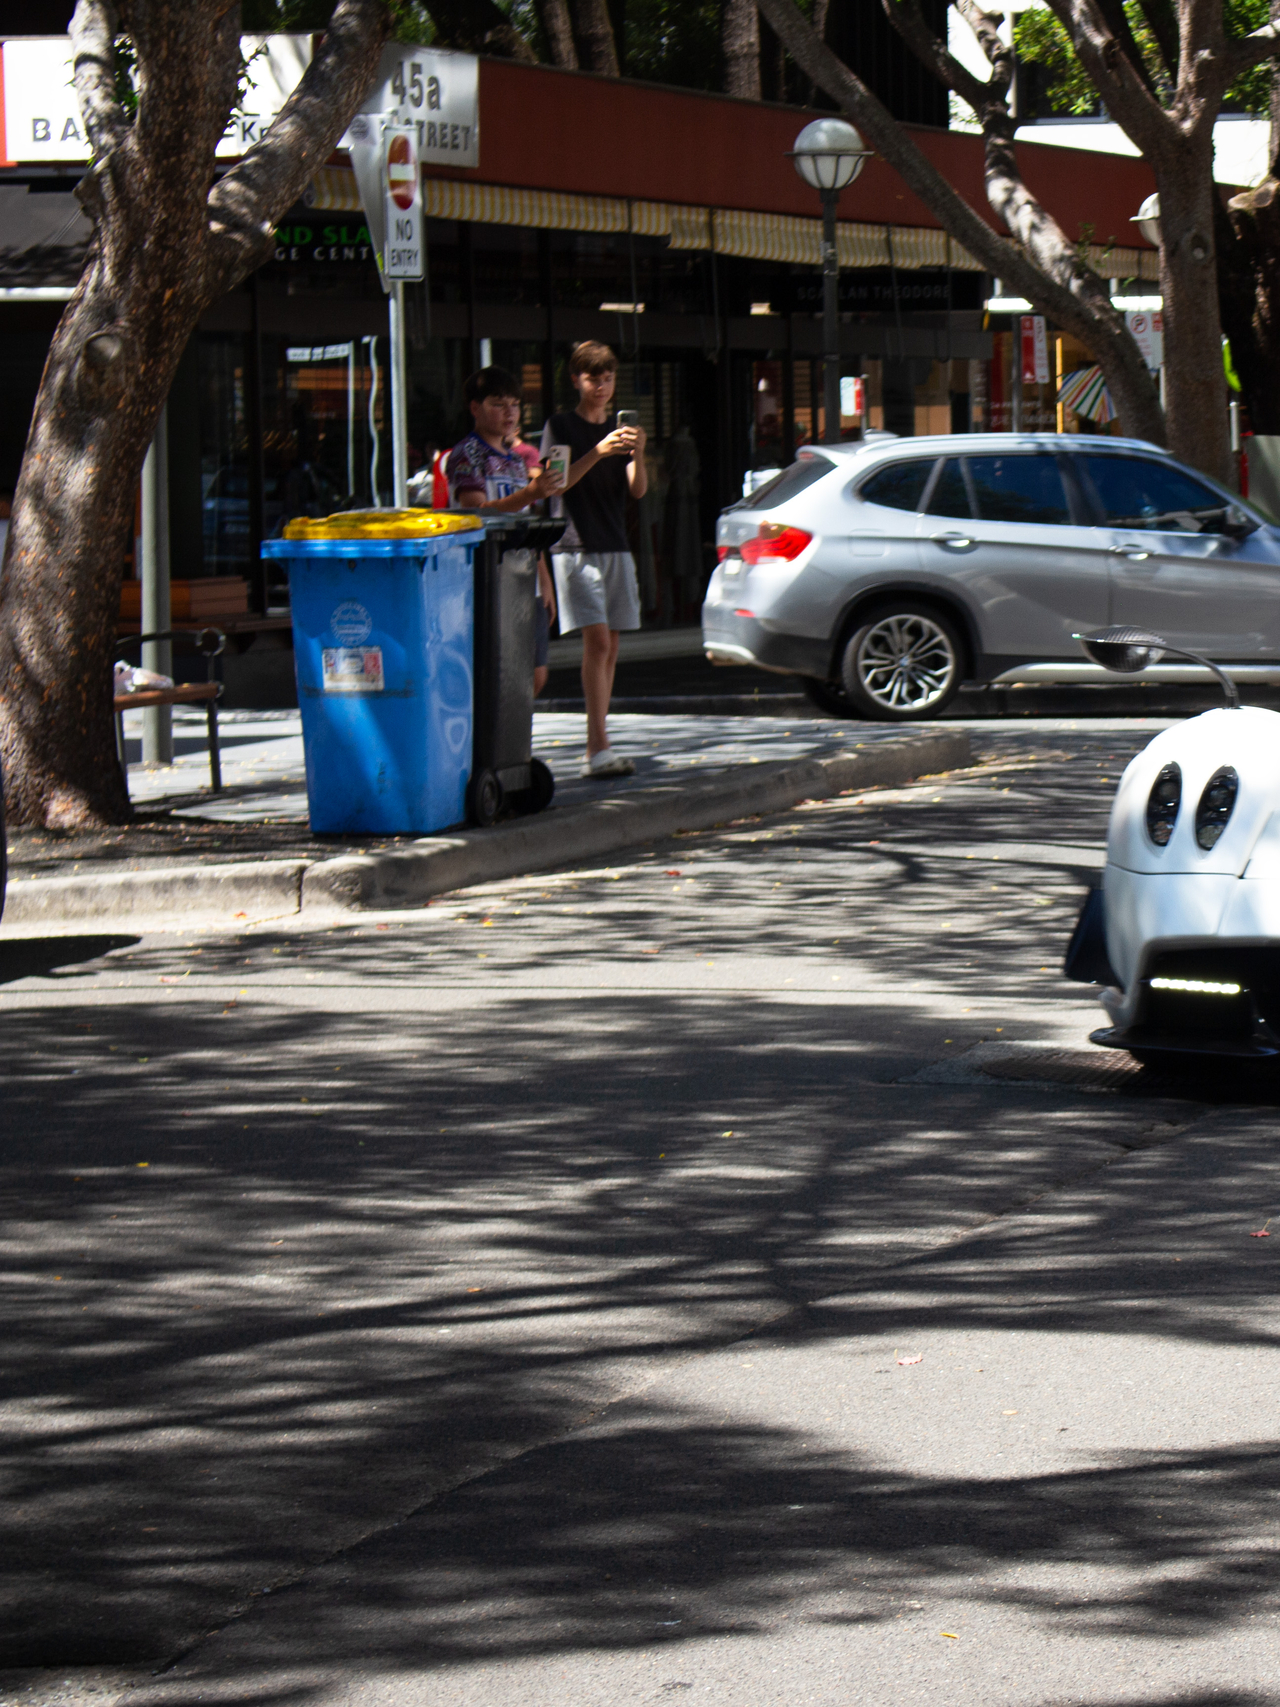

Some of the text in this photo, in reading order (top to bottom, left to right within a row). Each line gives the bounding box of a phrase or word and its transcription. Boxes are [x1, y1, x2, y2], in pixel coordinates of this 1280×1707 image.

[391, 60, 441, 111] 45a
[274, 226, 372, 245] ND SLA
[395, 218, 414, 242] NO
[274, 247, 370, 261] GE CENT
[390, 248, 419, 268] ENTRY
[797, 285, 868, 300] SCALAN
